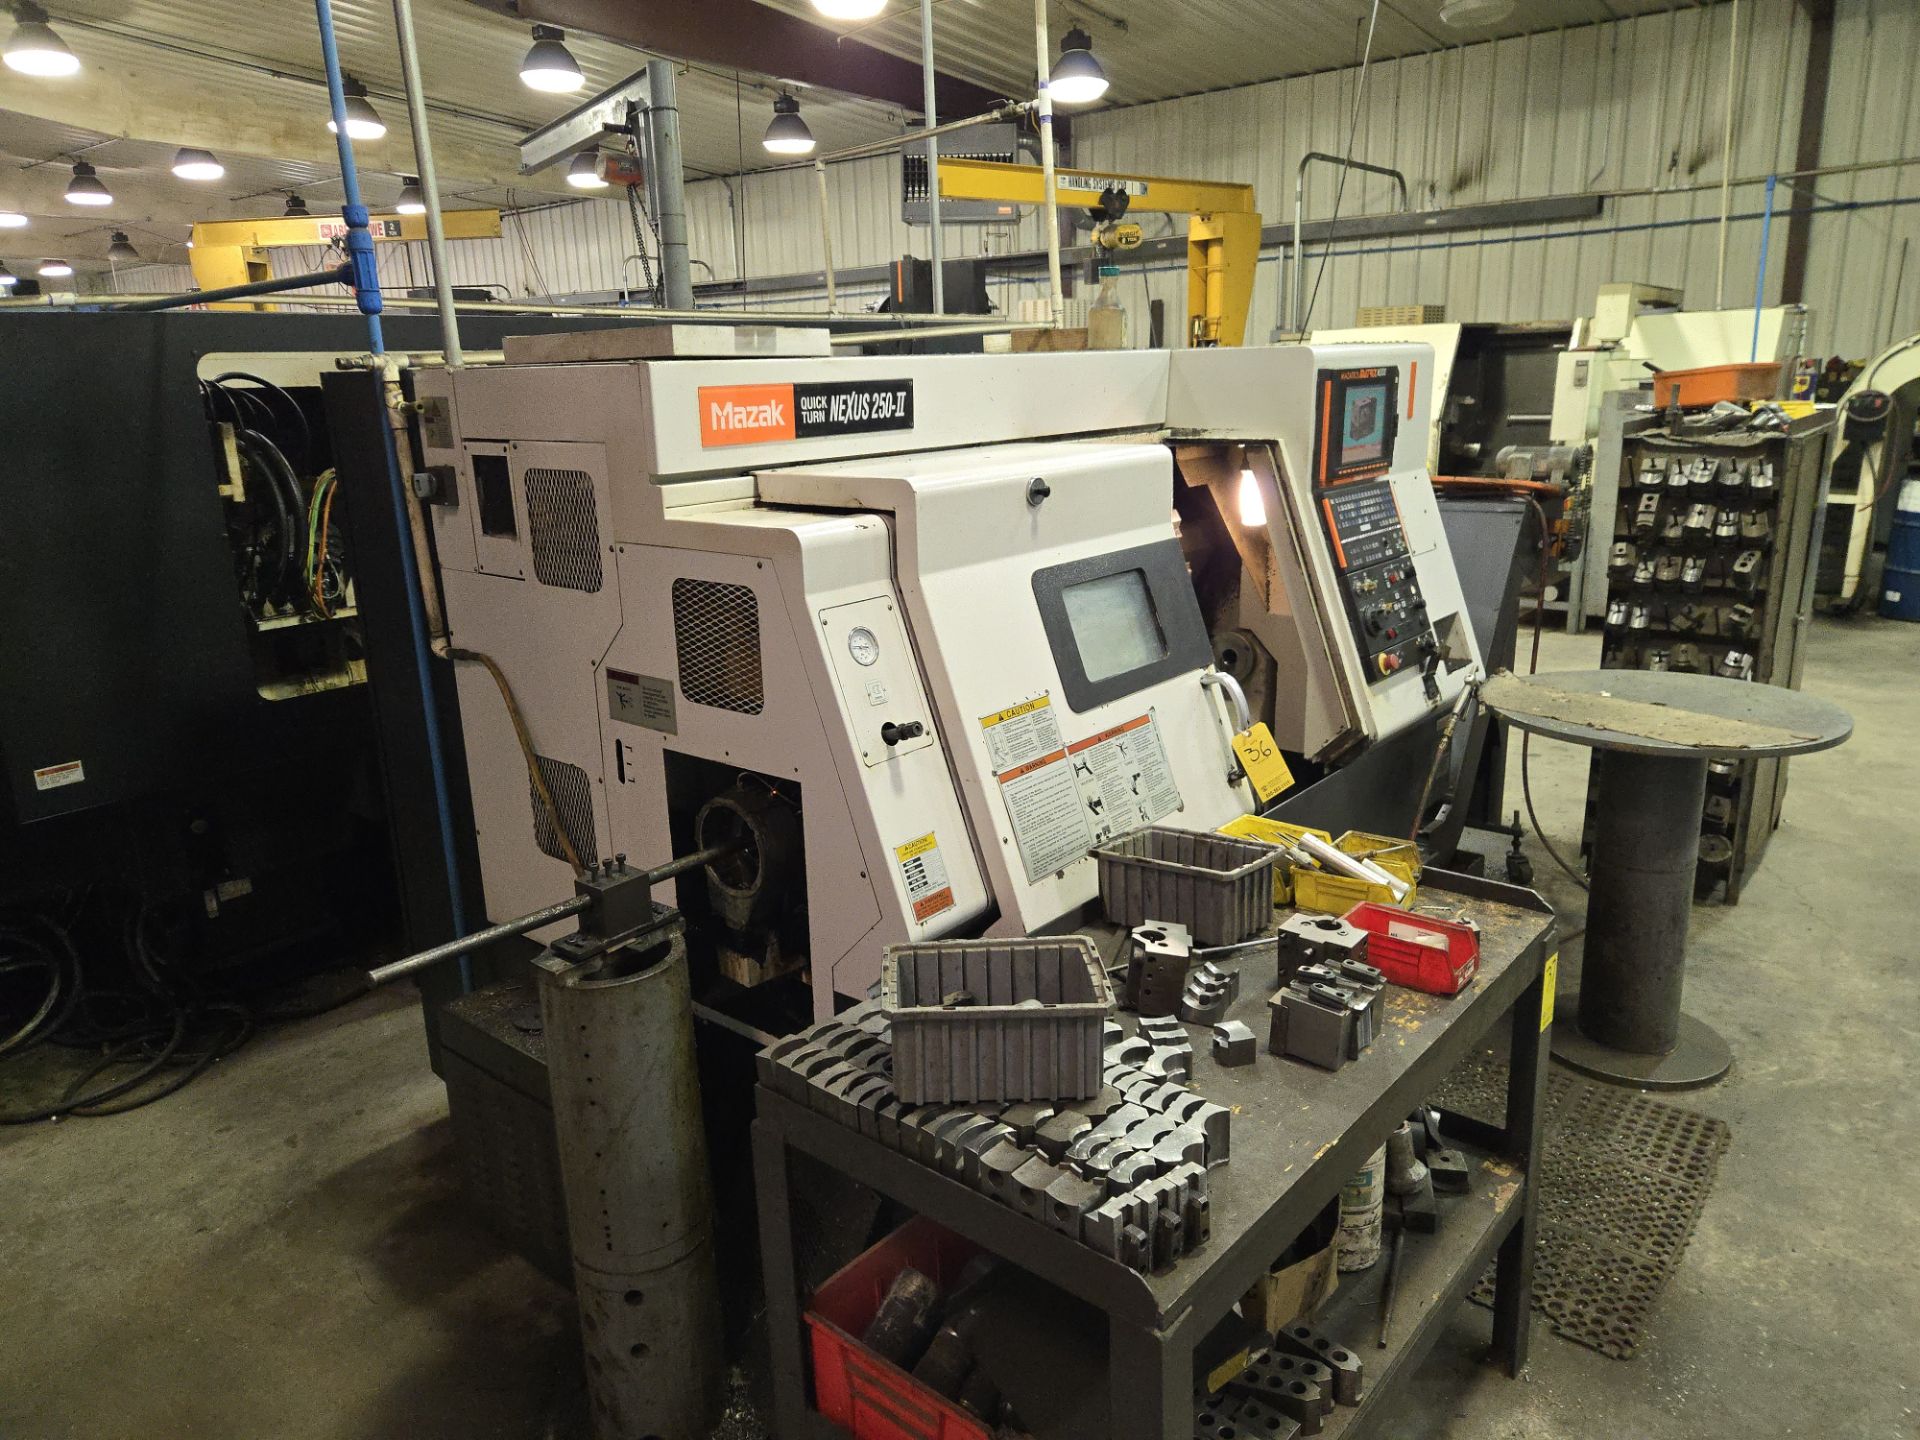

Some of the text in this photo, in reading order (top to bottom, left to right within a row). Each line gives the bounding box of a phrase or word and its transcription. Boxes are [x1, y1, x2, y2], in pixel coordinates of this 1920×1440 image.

[800, 395, 828, 411] QUICK
[829, 391, 907, 424] NEXUS 250-II
[711, 399, 785, 432] Mazak
[801, 410, 825, 424] TURN
[1006, 702, 1035, 718] CAUTION
[1243, 740, 1272, 762] 36
[1025, 759, 1047, 772] WARNING
